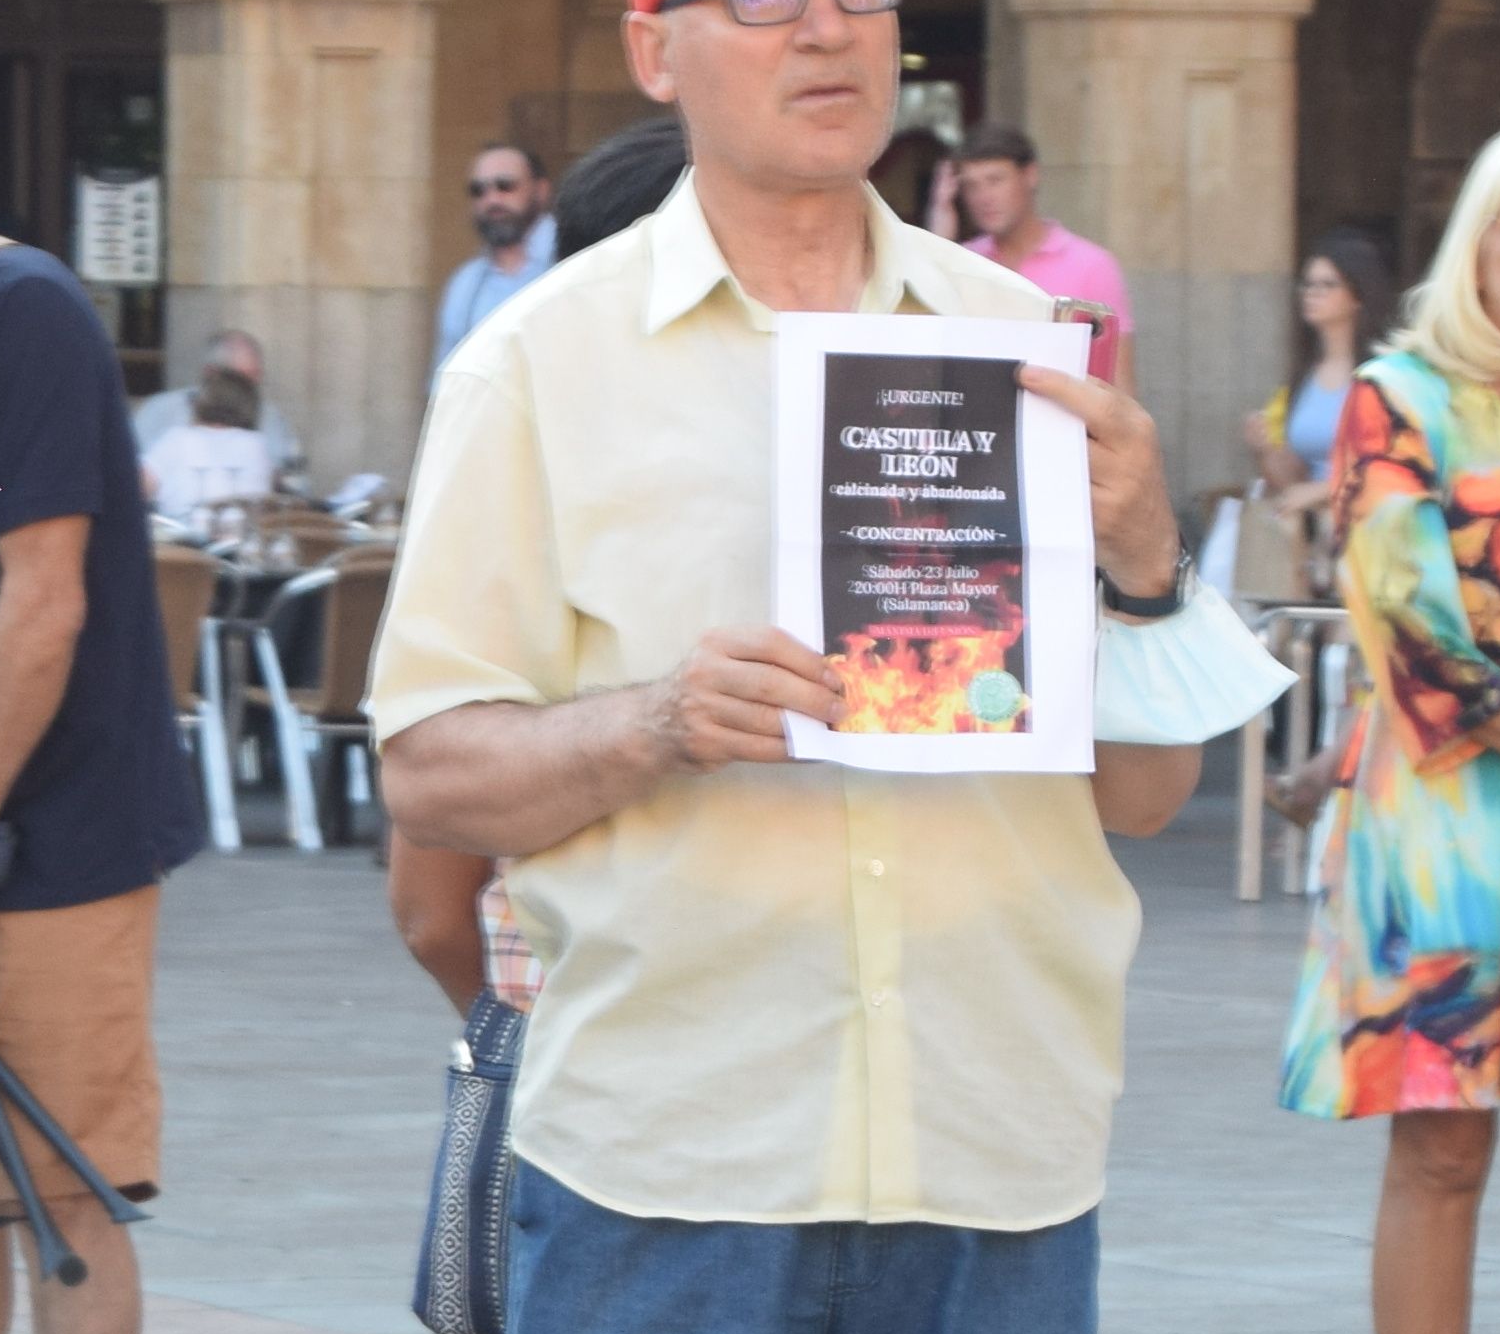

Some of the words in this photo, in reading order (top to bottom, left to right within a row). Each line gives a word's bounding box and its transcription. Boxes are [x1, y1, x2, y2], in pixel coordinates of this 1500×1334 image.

[842, 426, 973, 452] CASTILLA
[972, 430, 997, 453] Y
[881, 451, 958, 478] LEÓN
[830, 481, 905, 497] calcinada
[921, 484, 1006, 500] abandonada
[923, 565, 943, 579] 23
[909, 581, 948, 596] Plaza
[950, 583, 1000, 600] Mayor
[879, 596, 970, 615] (Salamanca)
